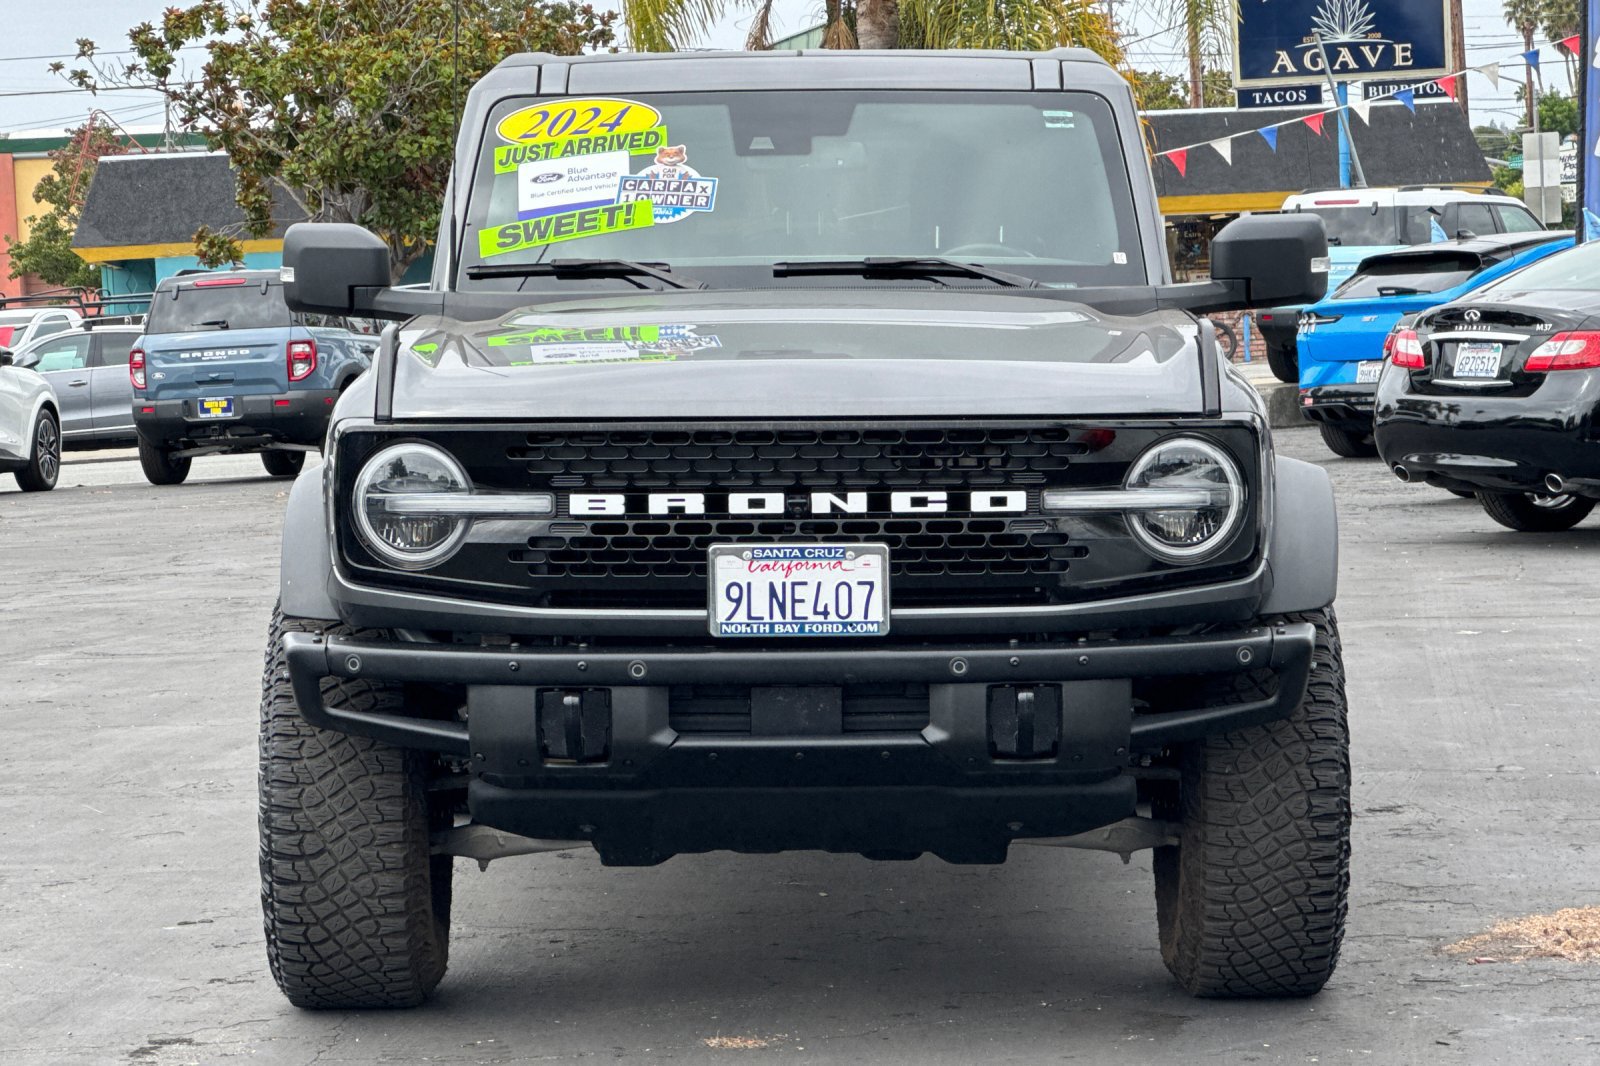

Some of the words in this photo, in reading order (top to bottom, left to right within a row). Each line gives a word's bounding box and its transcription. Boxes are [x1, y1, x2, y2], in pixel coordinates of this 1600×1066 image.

[1271, 43, 1413, 73] AGAVE
[1252, 89, 1307, 104] TACOS
[520, 104, 632, 139] 2024
[498, 141, 557, 167] JUST
[561, 130, 660, 156] ARRIVED
[567, 171, 617, 182] Advantage
[546, 188, 574, 196] Certified
[625, 181, 708, 194] CARFAX
[496, 204, 637, 248] SWEET!
[1536, 323, 1552, 331] M37
[180, 349, 250, 358] BRONCO
[1458, 356, 1497, 371] 6PZG512
[569, 490, 1026, 515] BRONCO
[753, 549, 802, 558] SANTA
[804, 549, 844, 558] CRUZ
[748, 560, 855, 579] California
[725, 581, 875, 621] 9LNE407
[721, 623, 770, 634] NORTH
[774, 623, 801, 634] BAY
[804, 622, 878, 633] FORD.COM
